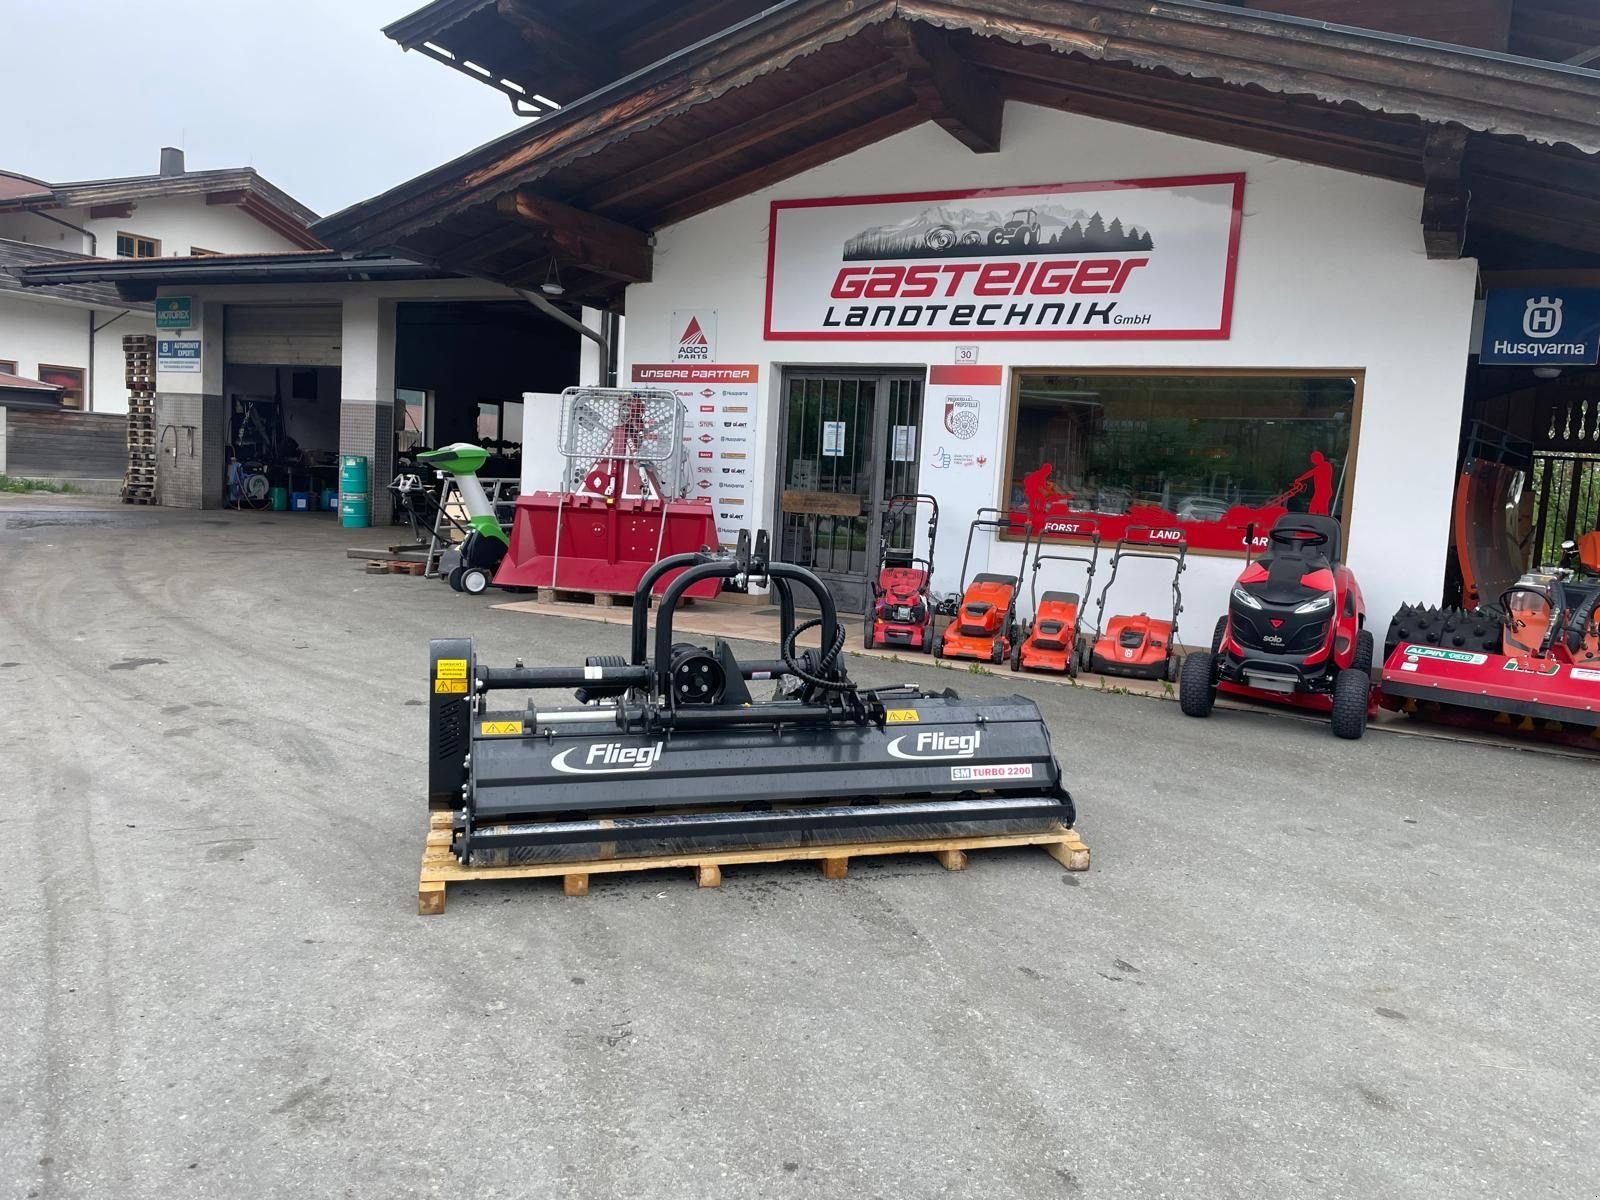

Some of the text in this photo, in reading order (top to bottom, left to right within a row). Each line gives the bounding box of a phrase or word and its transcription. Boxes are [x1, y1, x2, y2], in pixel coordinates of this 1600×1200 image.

[830, 258, 1149, 299] GASTEIGER
[1113, 314, 1152, 325] GmbH
[678, 346, 708, 354] AGCO
[1494, 340, 1585, 357] Husqvarna
[960, 351, 972, 359] 30
[640, 370, 750, 379] UNSERE PARTNER
[1044, 522, 1080, 533] FORST
[1149, 530, 1181, 540] LAND
[1262, 635, 1283, 643] solo
[1406, 647, 1446, 658] ALPIN
[916, 730, 981, 754] Fliegl
[585, 741, 664, 767] Fliegl
[953, 767, 1031, 778] SM TURBO 2200
